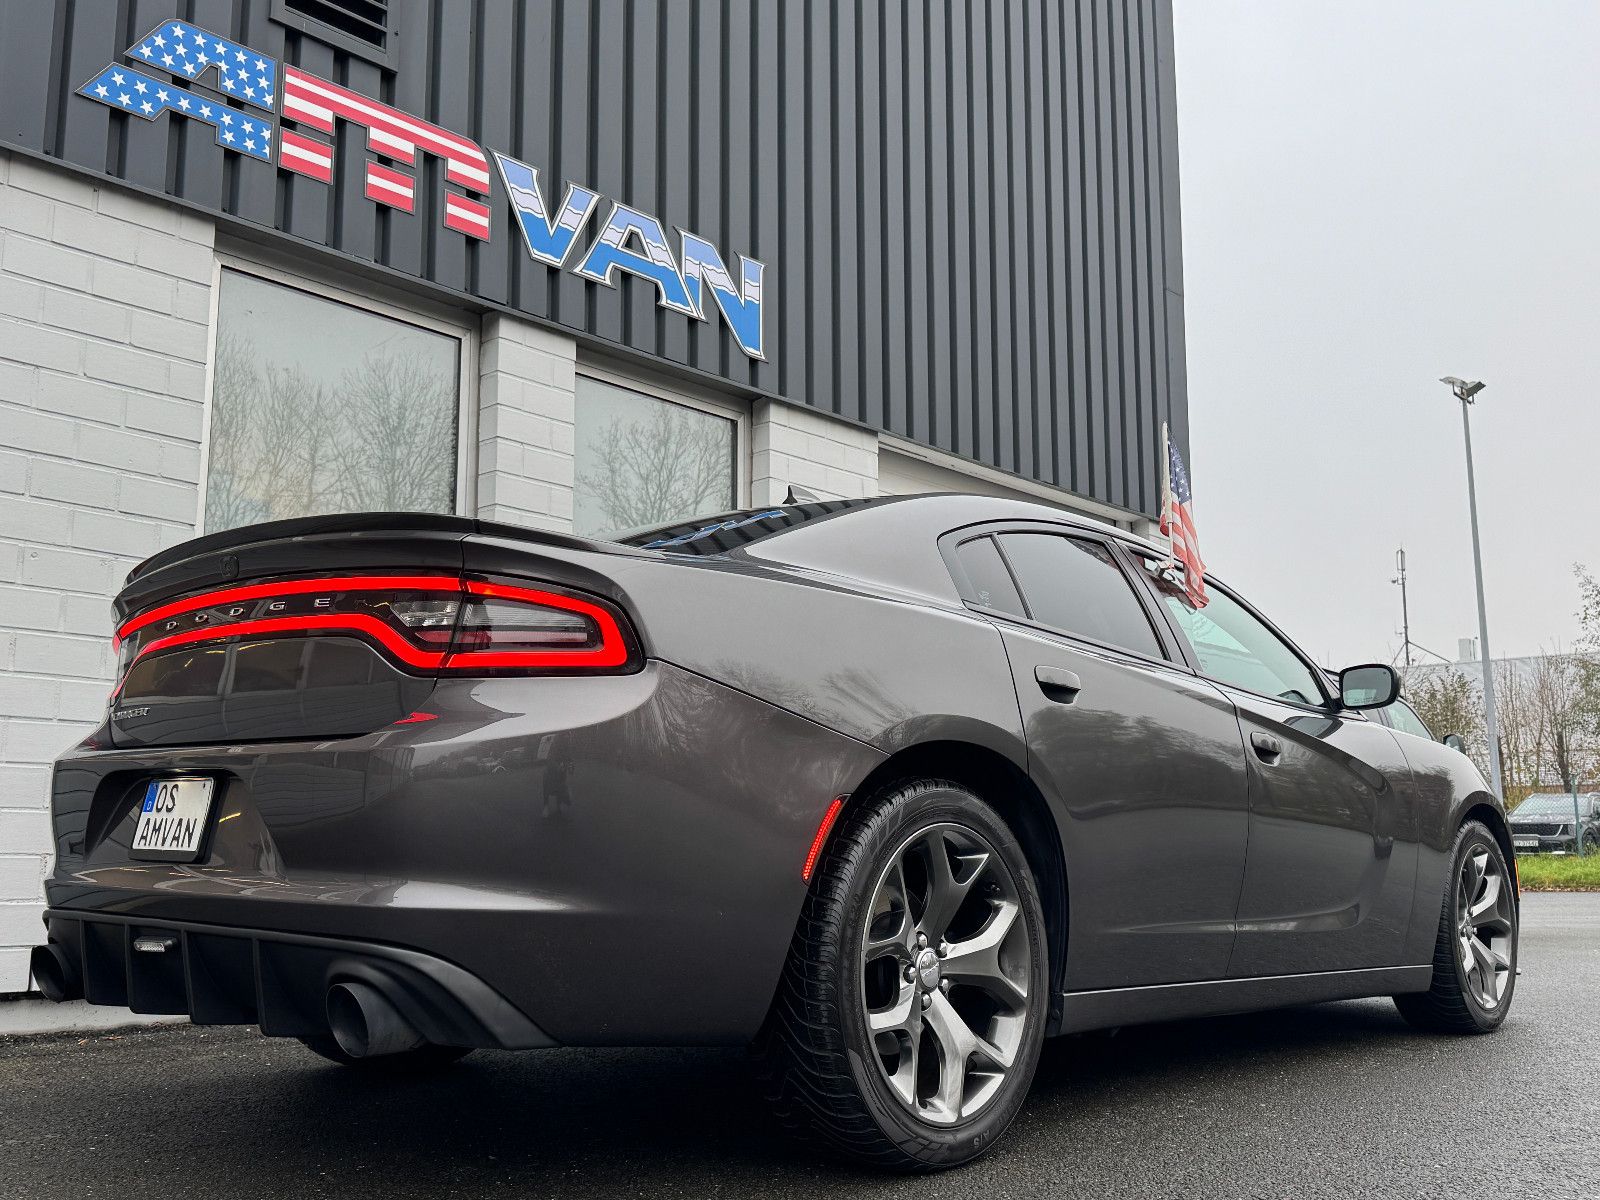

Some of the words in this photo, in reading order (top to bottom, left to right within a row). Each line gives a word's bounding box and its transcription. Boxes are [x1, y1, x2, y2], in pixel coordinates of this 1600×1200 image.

[166, 598, 331, 631] DODGE
[155, 783, 179, 813] OS
[137, 818, 197, 848] AMVAN
